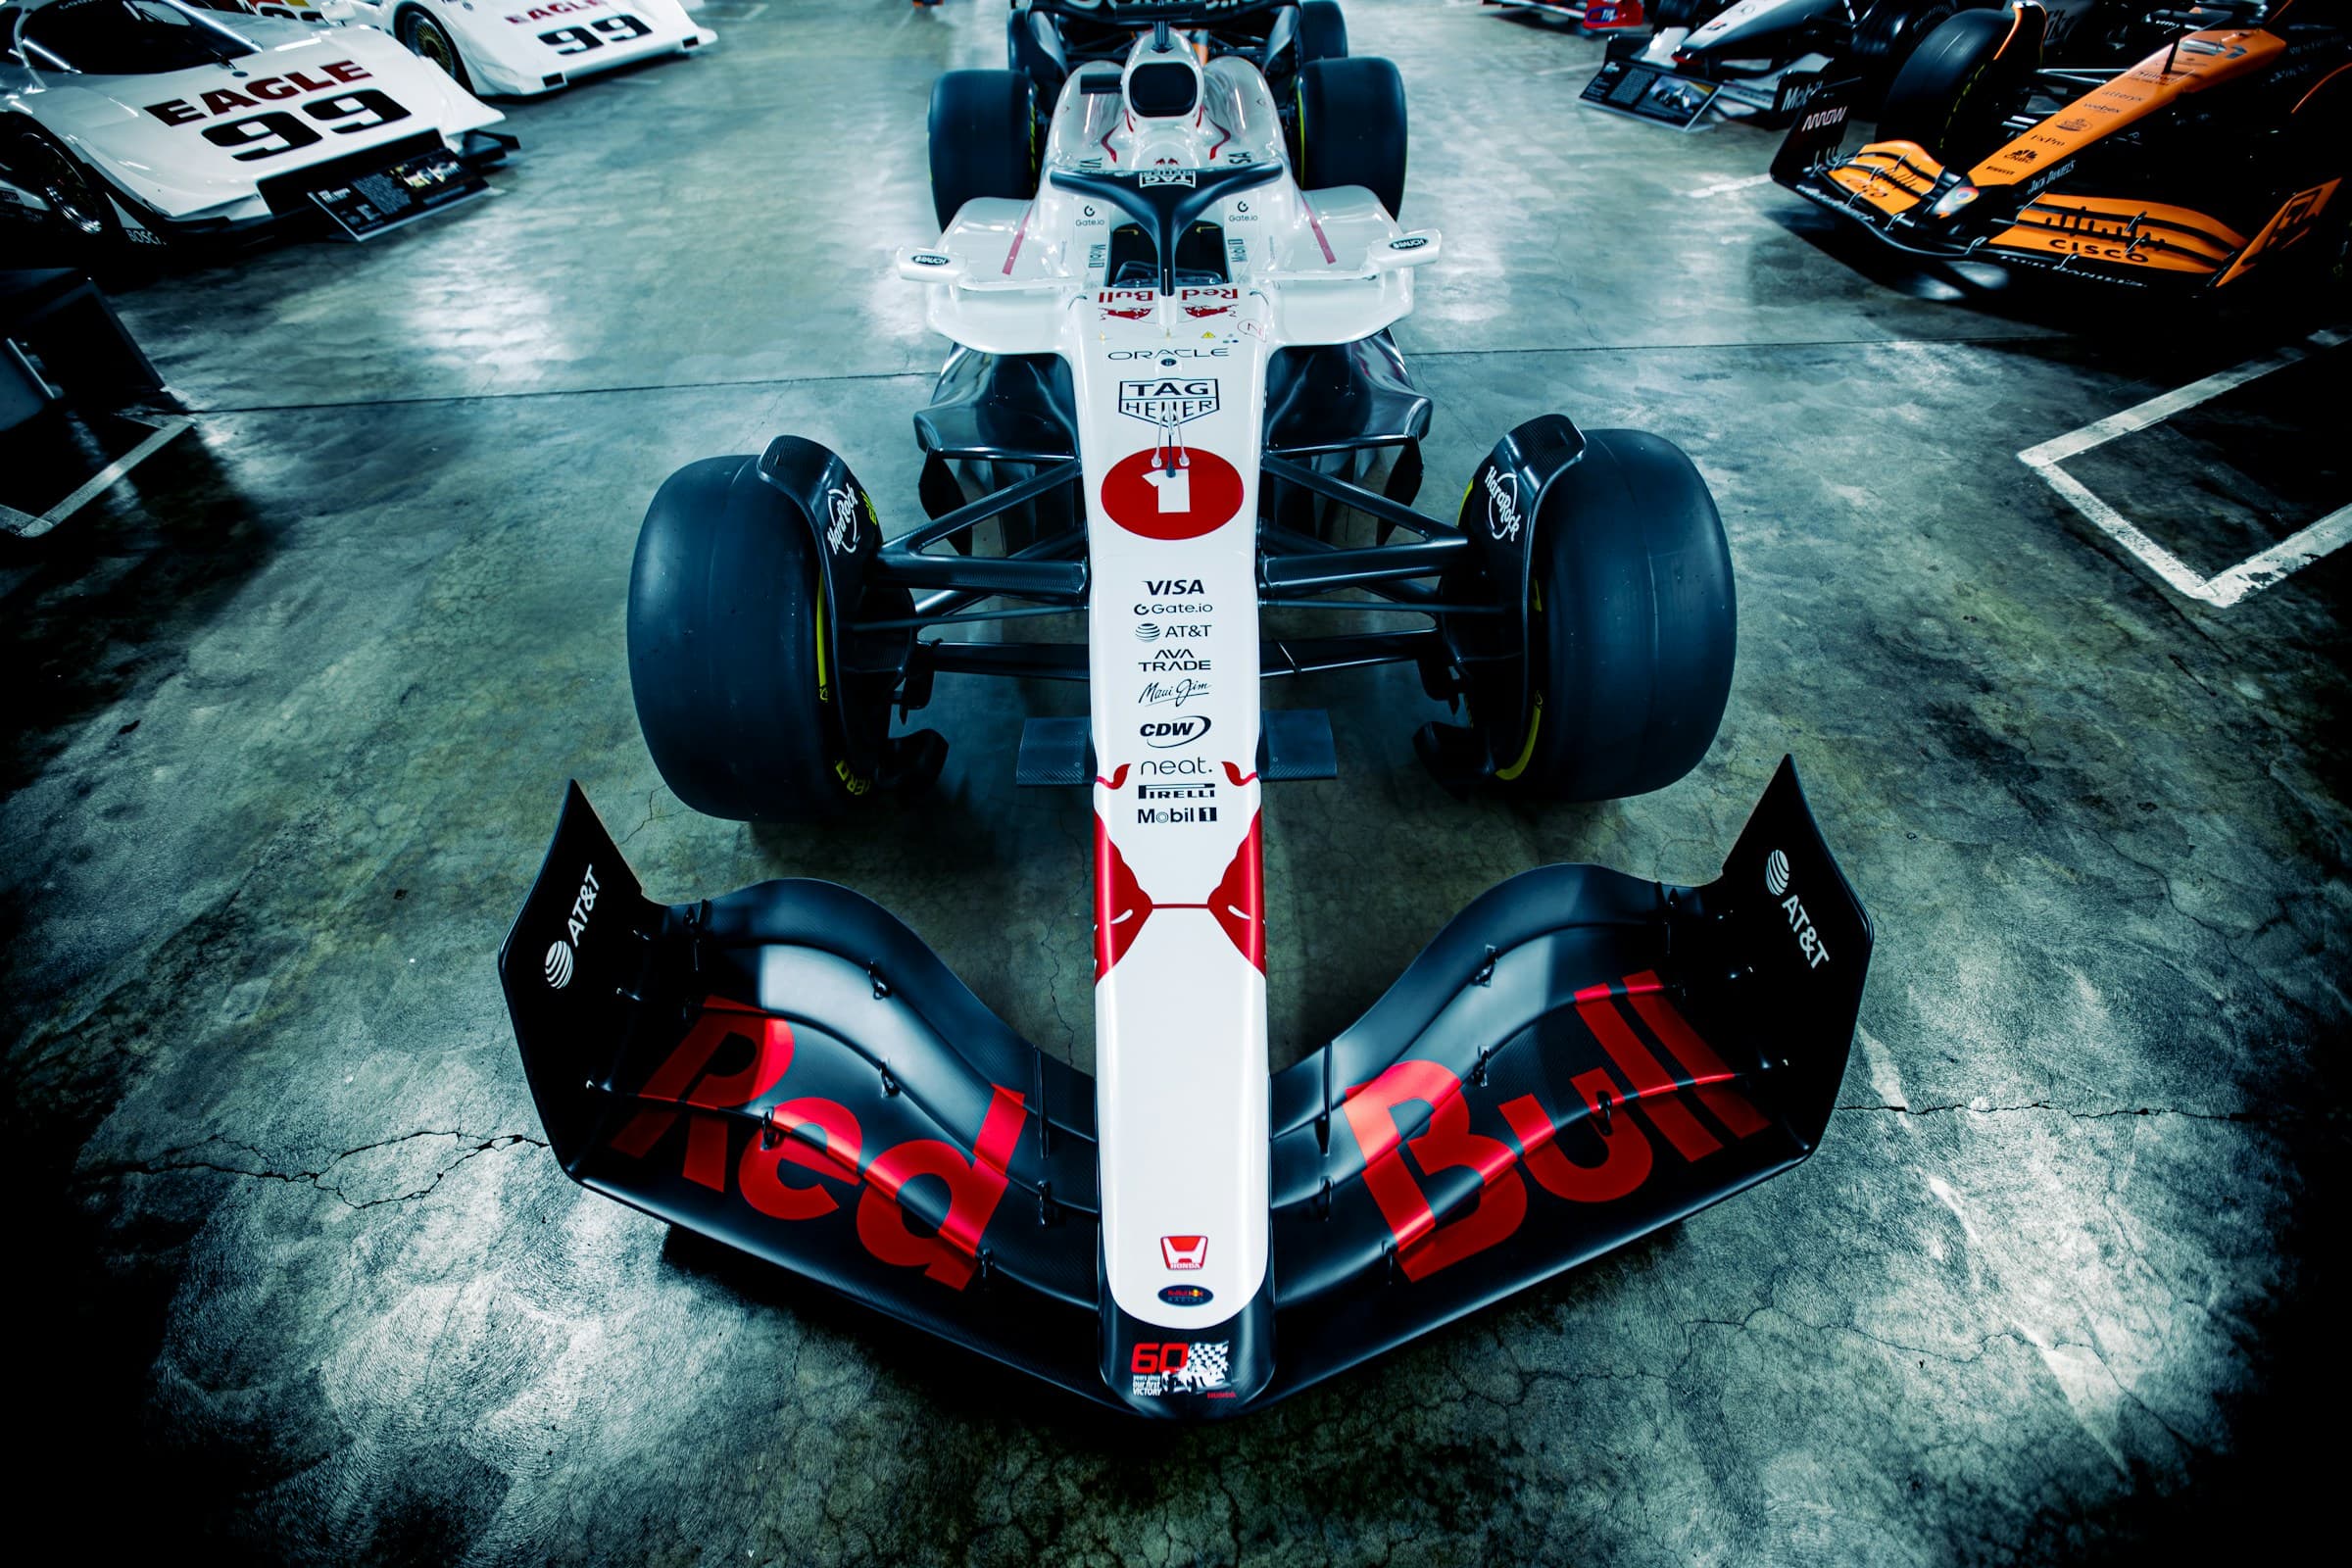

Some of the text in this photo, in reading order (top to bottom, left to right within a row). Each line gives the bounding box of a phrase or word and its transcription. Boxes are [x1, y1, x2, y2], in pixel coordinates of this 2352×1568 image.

[536, 14, 653, 56] 99
[143, 60, 373, 126] EAGLE
[201, 89, 412, 162] 99
[1075, 219, 1104, 227] Gate.io
[1229, 214, 1258, 222] Gate.io
[2048, 238, 2149, 264] CISCO
[1098, 288, 1239, 303] Red Bull
[1107, 347, 1230, 361] ORACLE
[1128, 381, 1210, 397] TAG
[1125, 400, 1213, 422] HEUER
[1141, 467, 1192, 514] 1
[1142, 579, 1205, 596] VISA
[1151, 603, 1213, 614] Gate.io
[1164, 624, 1213, 639] AT&T
[1153, 648, 1195, 660] AVA
[1137, 660, 1212, 672] TRADE
[1138, 678, 1212, 708] Maui Jim
[1140, 722, 1195, 737] CDW
[1138, 783, 1216, 800] PIRELLI
[1137, 808, 1216, 824] Mobil 1
[566, 863, 602, 948] AT&T
[1782, 893, 1831, 970] AT&T
[610, 969, 1772, 1292] Red Bull
[1132, 1343, 1189, 1374] 60
[1132, 1388, 1162, 1396] VICTORY
